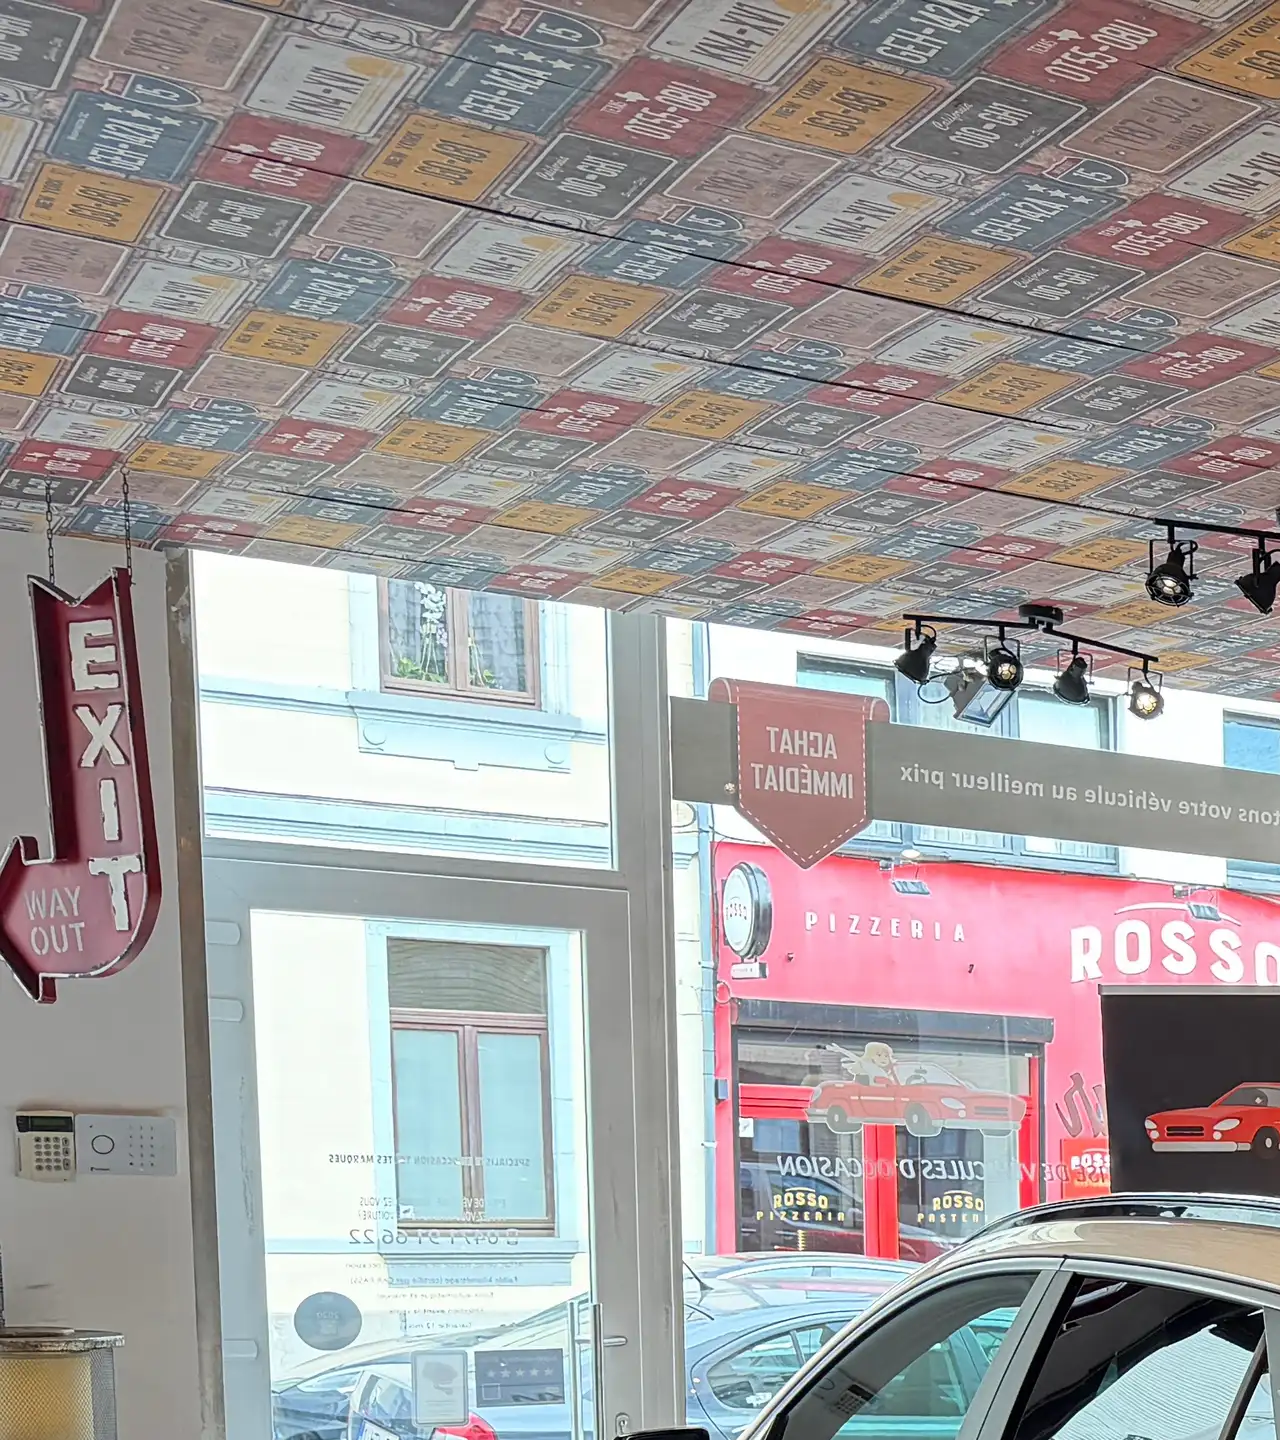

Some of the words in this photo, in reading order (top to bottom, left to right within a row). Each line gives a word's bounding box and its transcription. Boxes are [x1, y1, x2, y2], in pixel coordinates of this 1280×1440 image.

[1209, 41, 1238, 60] NEW
[1073, 167, 1113, 183] 15
[67, 618, 145, 932] EXIT
[24, 886, 81, 920] WAY
[805, 911, 966, 942] PIZZERIA
[30, 922, 86, 957] OUT
[773, 1191, 829, 1210] ROSSO
[933, 1194, 984, 1212] ROSSO
